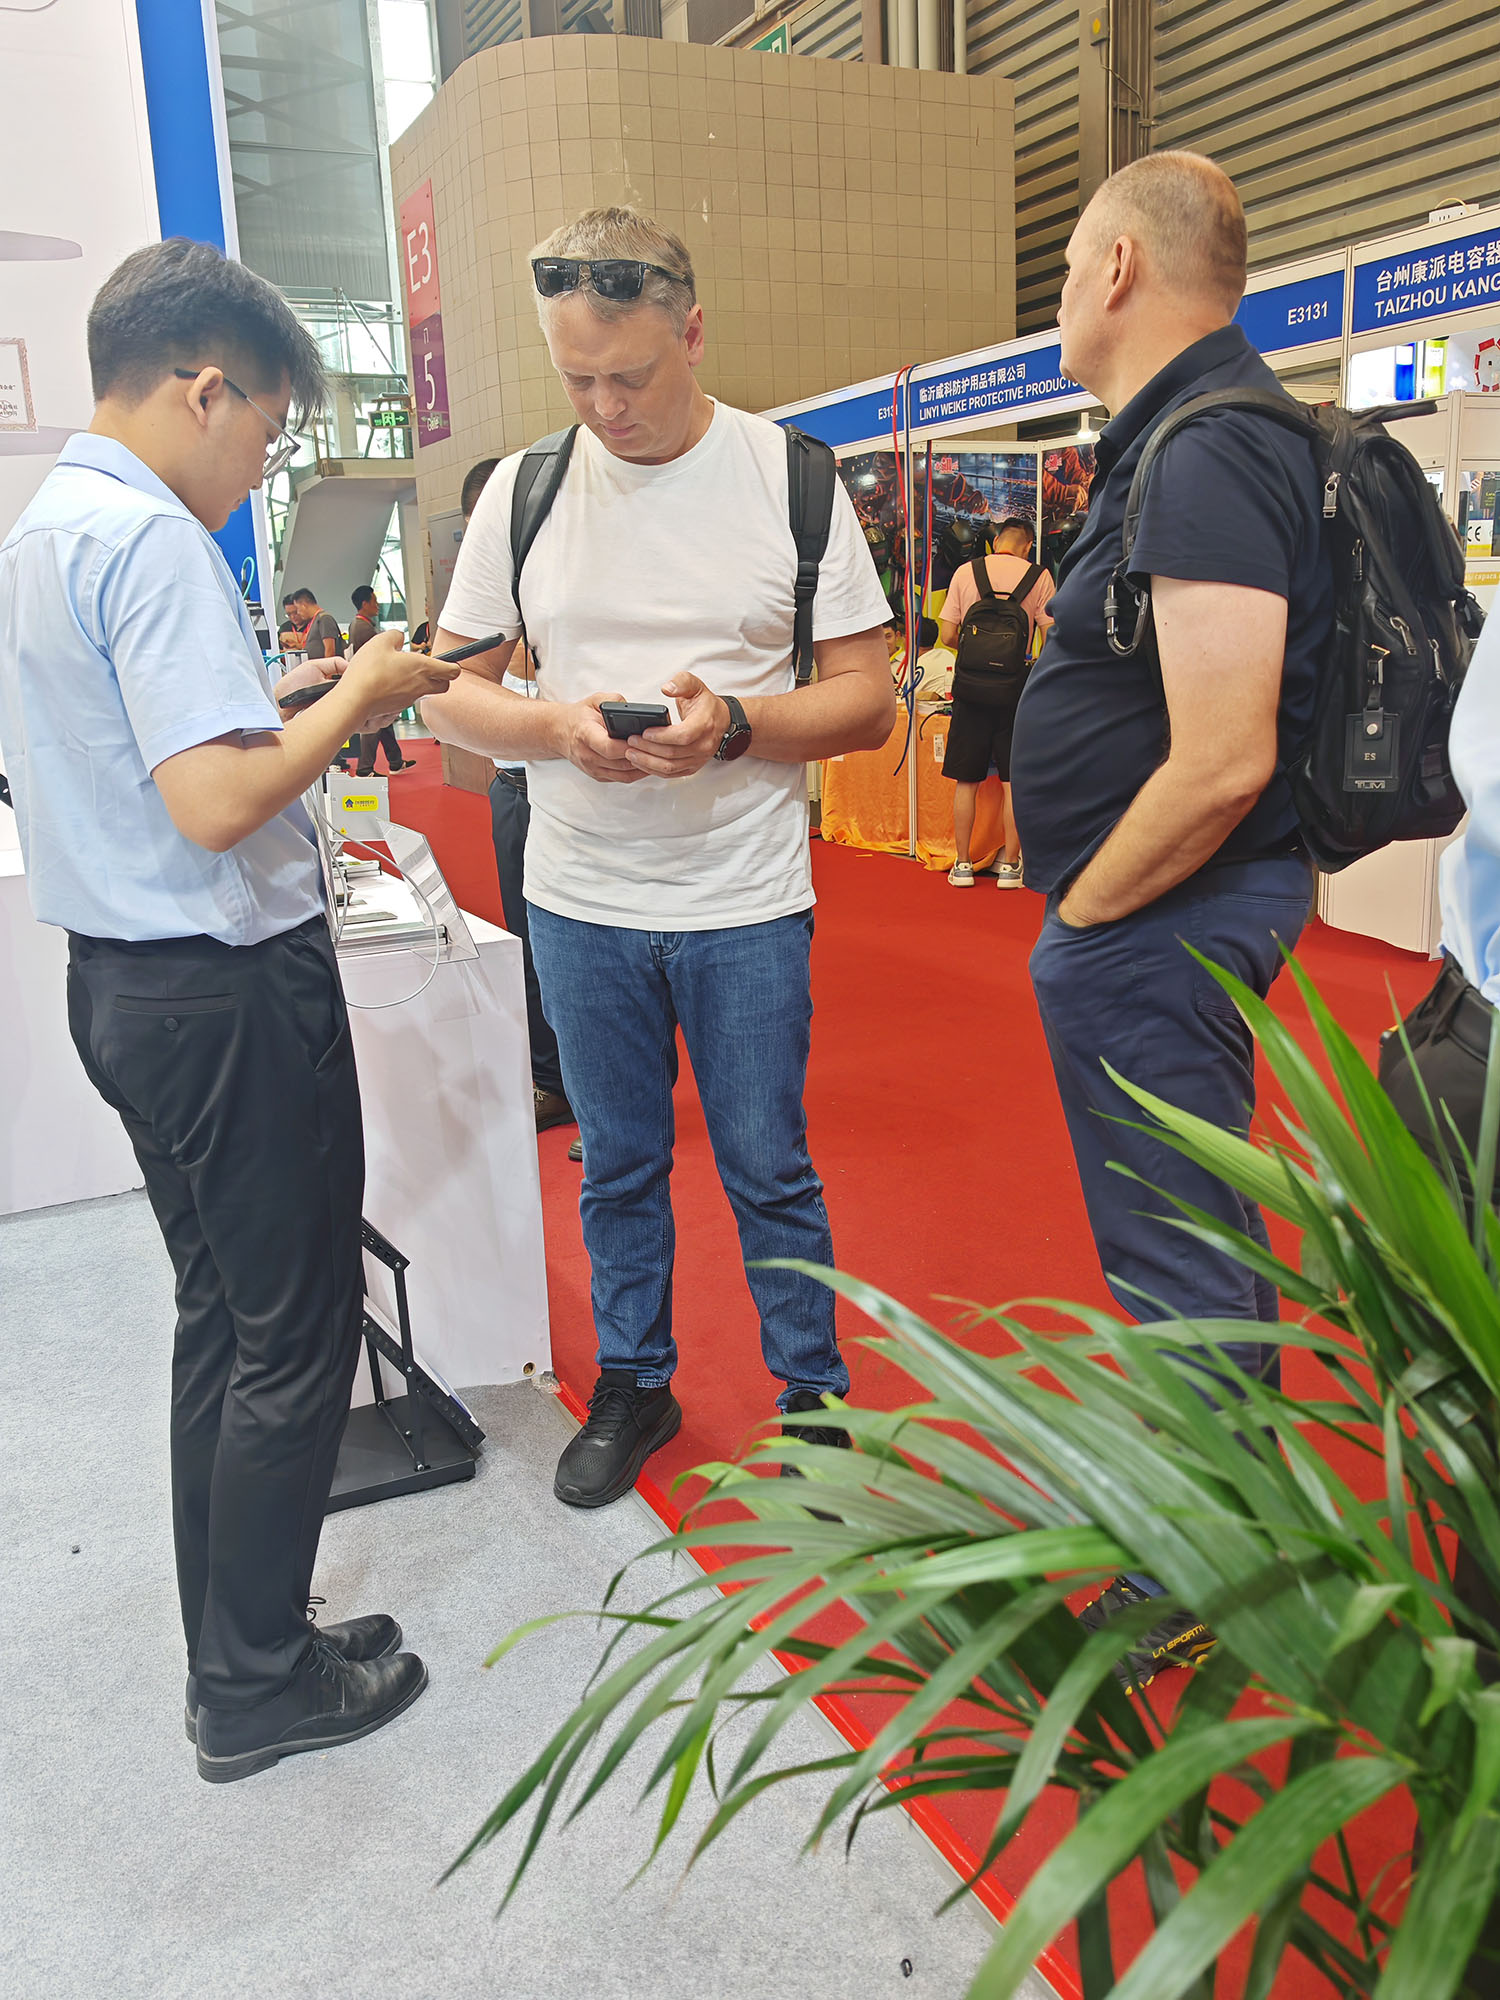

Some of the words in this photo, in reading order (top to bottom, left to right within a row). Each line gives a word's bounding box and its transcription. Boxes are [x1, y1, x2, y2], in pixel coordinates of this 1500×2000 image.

[406, 221, 432, 294] E3
[1376, 240, 1500, 294] 台州康派电容器
[1287, 301, 1328, 325] E3131
[1374, 285, 1447, 318] TAIZHOU
[1452, 272, 1500, 301] KANG
[424, 351, 436, 410] 5
[919, 405, 939, 420] LINYI
[940, 399, 967, 416] WEIKE
[968, 386, 1024, 410] PROTECTIVE
[1364, 752, 1377, 761] ES
